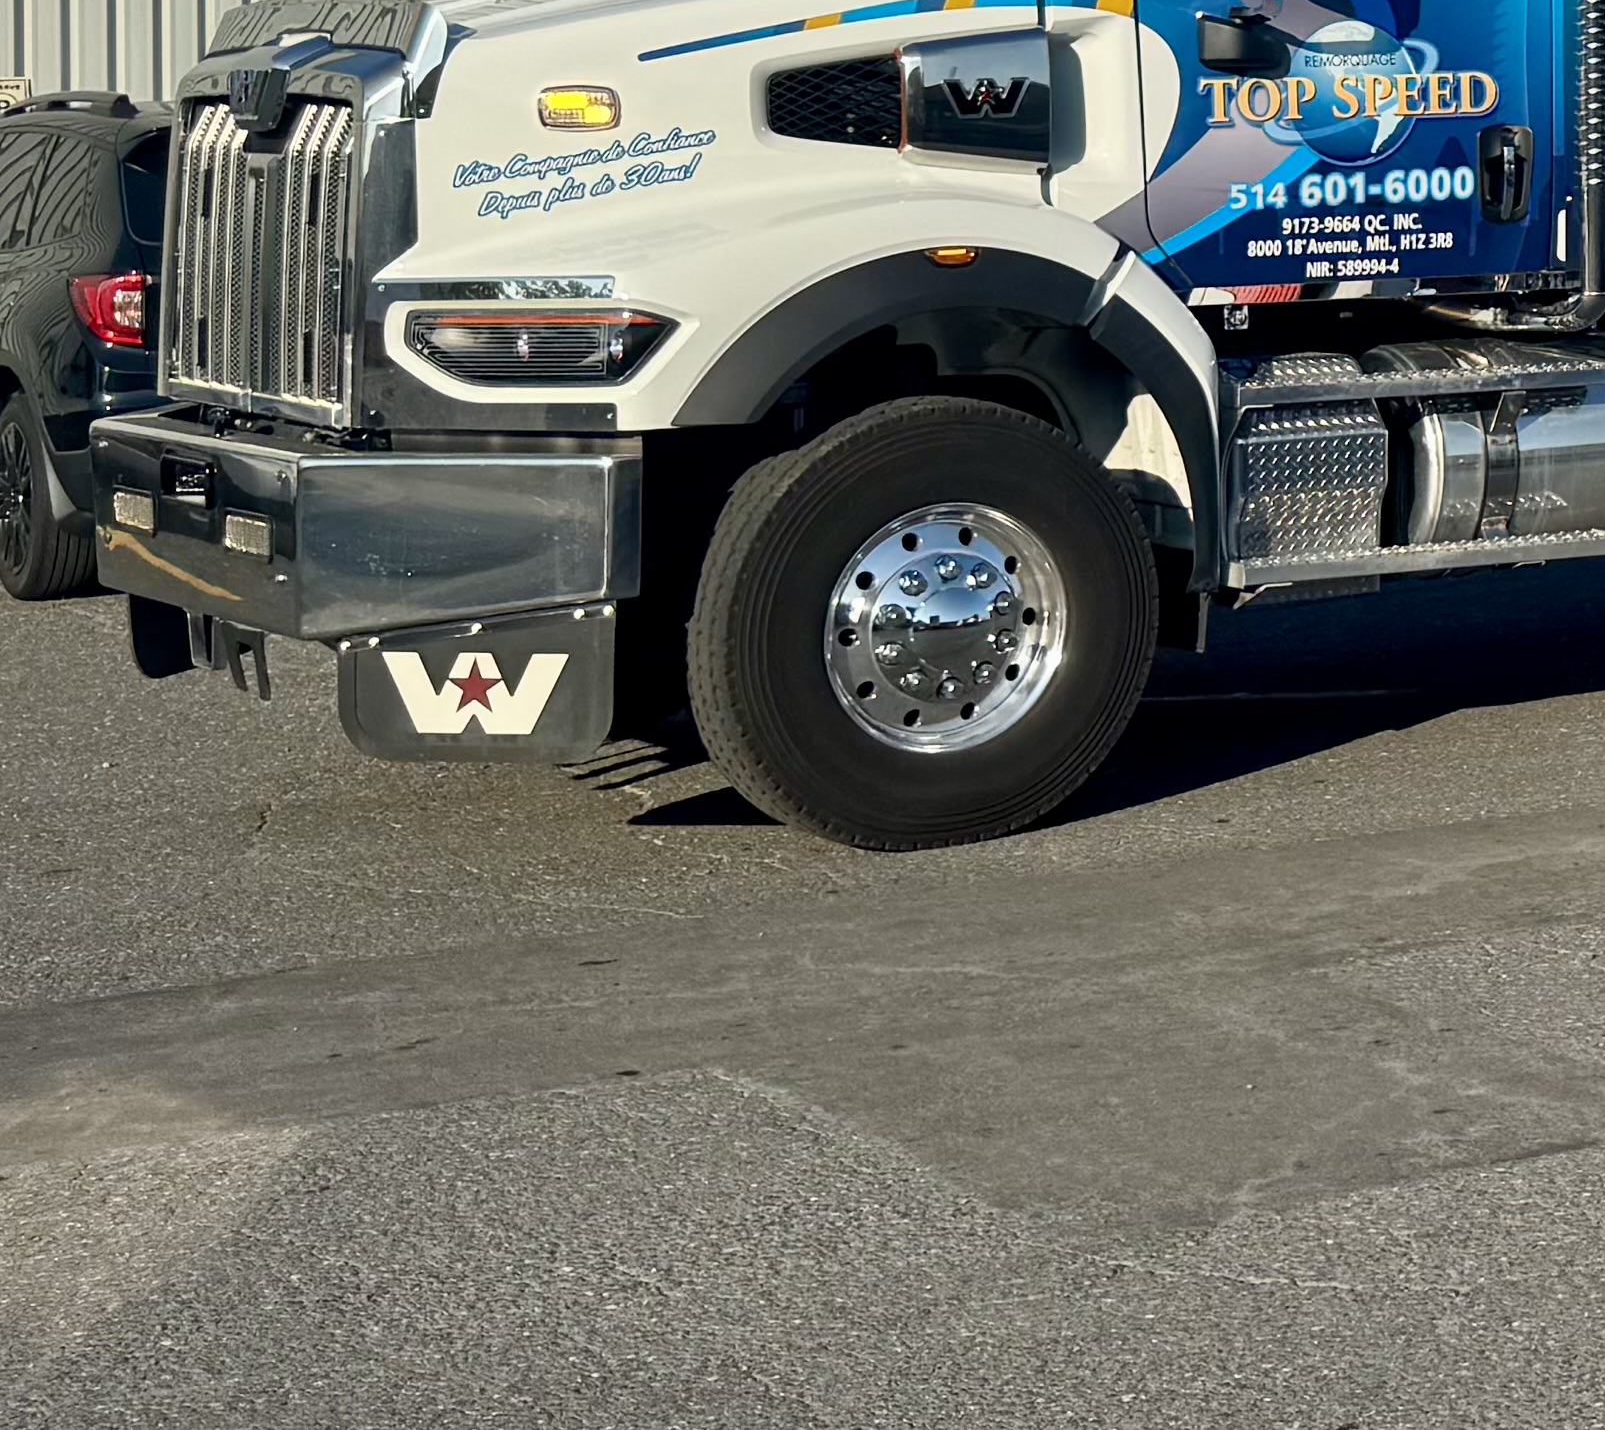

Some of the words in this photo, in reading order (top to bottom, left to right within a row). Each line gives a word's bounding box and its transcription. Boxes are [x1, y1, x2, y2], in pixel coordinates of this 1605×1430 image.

[1304, 54, 1397, 68] REMORQUAGE
[1199, 75, 1316, 124] TOP
[1332, 71, 1499, 119] SPEED
[501, 153, 599, 179] Compagnie
[600, 140, 626, 163] de
[626, 127, 716, 157] Confiance
[478, 190, 544, 219] Depuis
[543, 177, 586, 211] plus
[590, 174, 616, 196] de
[1230, 182, 1288, 210] 514
[1300, 165, 1475, 208] 601-6000
[1282, 215, 1361, 235] 9173-9664
[1394, 213, 1422, 231] INC.
[1247, 239, 1282, 257] 8000
[1400, 235, 1426, 250] H1Z
[1429, 232, 1454, 250] 3R8
[1306, 260, 1334, 278] NIR:
[1337, 258, 1400, 277] 589994-4
